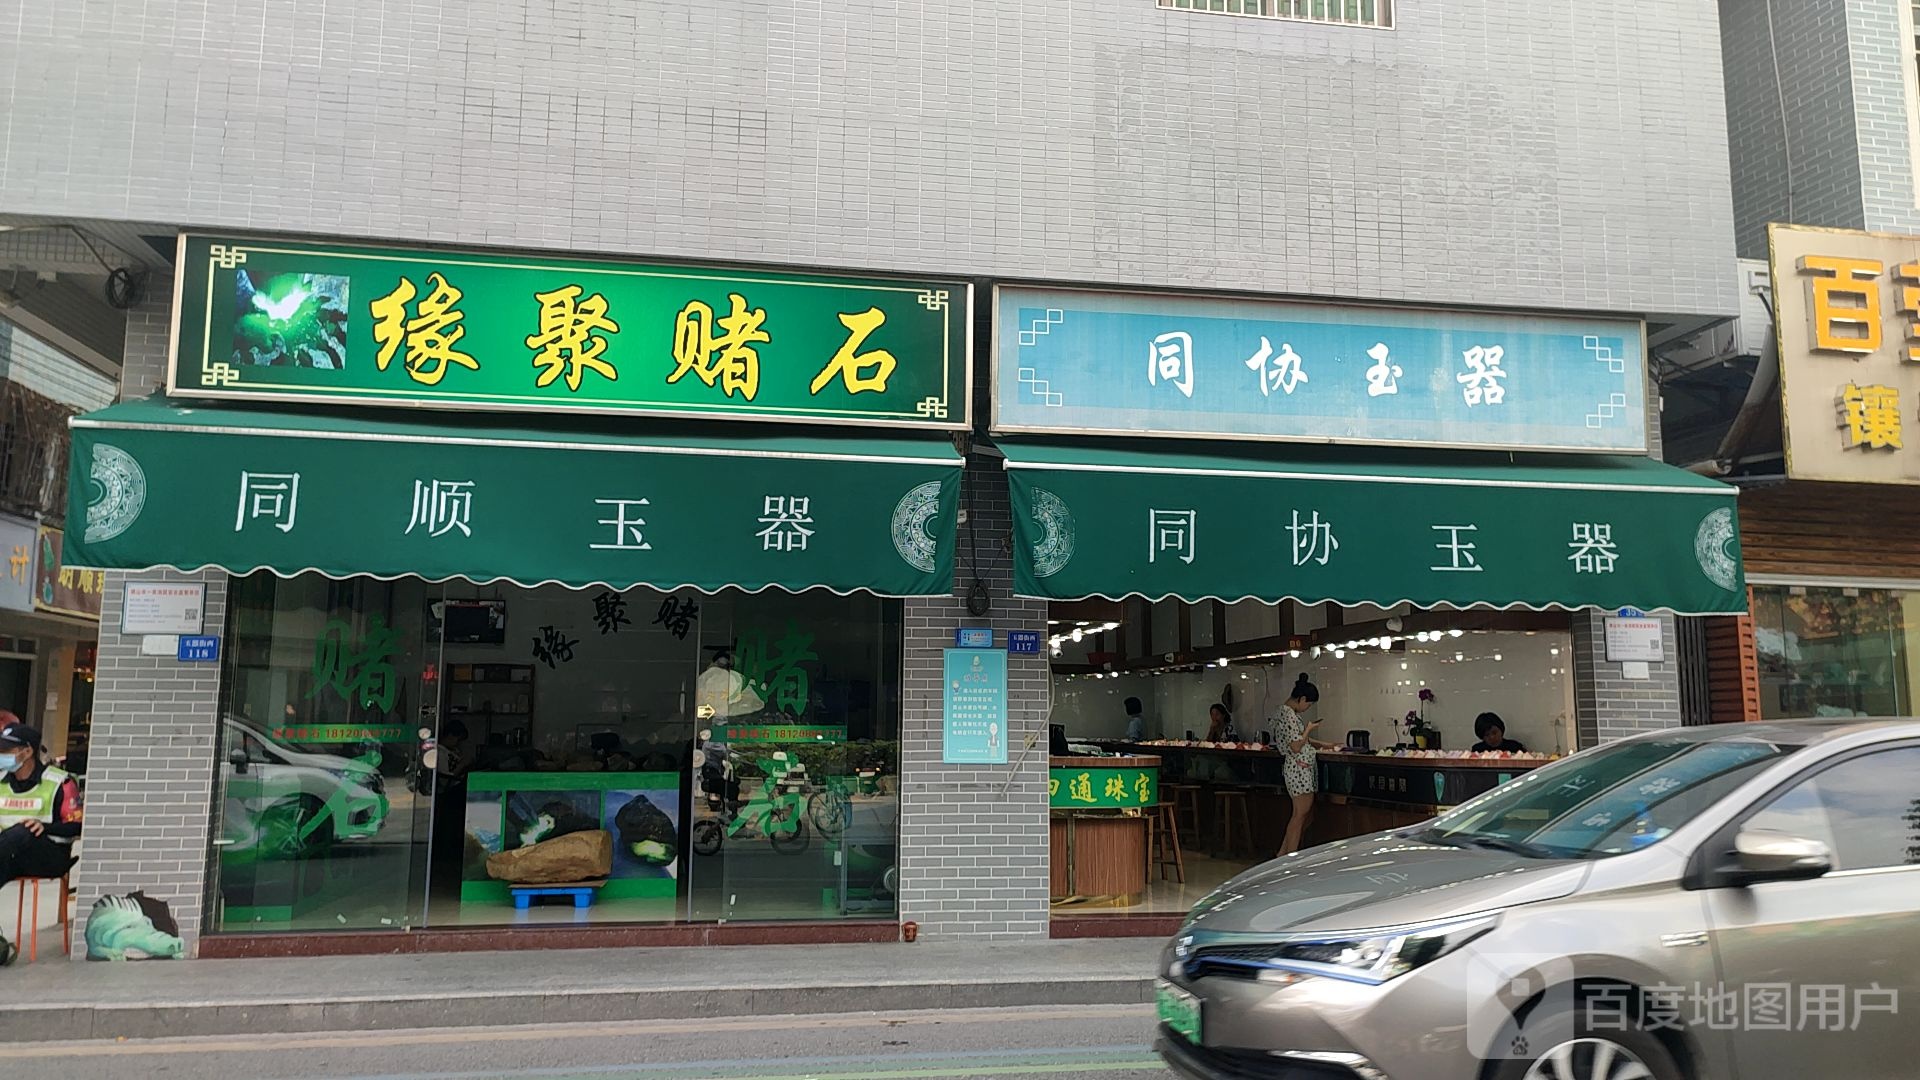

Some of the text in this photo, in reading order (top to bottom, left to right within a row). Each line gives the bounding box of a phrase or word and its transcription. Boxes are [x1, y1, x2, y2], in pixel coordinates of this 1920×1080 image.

[368, 272, 899, 402] 缘聚赌石
[1147, 331, 1507, 408] 同协玉器
[235, 470, 816, 554] 同顺玉器
[1148, 507, 1620, 574] 同协玉器
[188, 649, 209, 658] 118
[1016, 642, 1032, 651] 117
